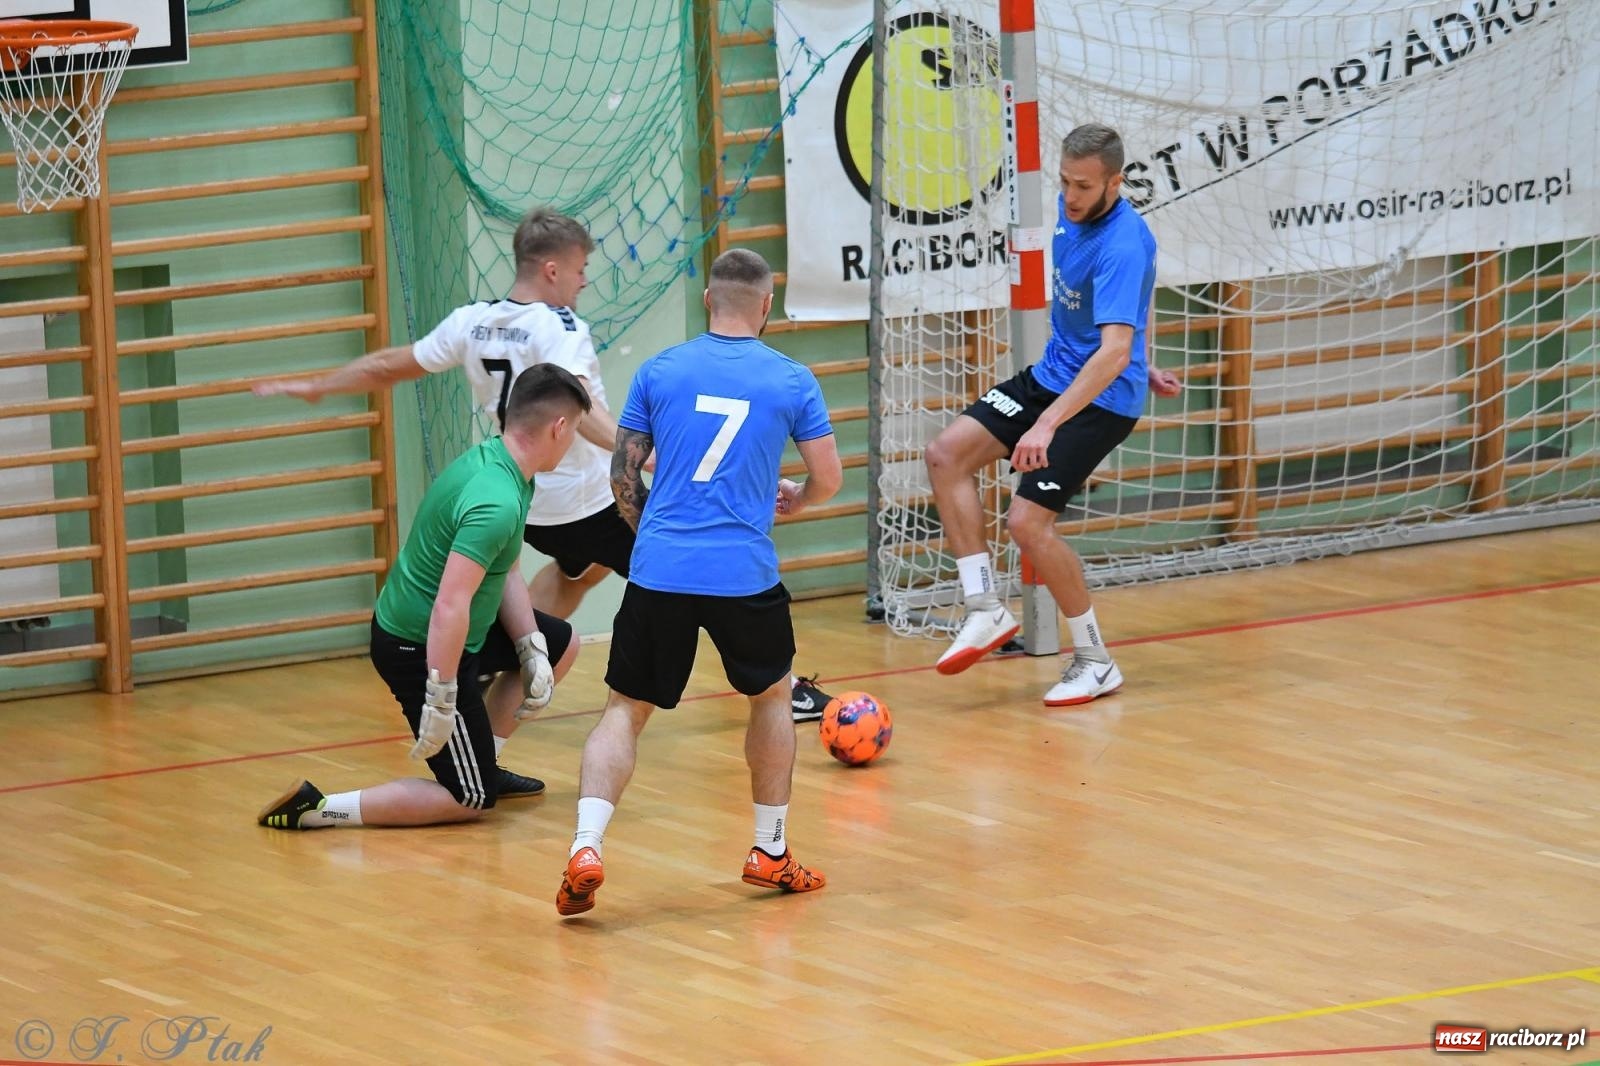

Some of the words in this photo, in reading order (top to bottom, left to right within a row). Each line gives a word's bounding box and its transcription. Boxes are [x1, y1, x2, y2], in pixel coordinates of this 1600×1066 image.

[1196, 115, 1249, 173] W
[1269, 167, 1572, 230] www.osir-raciborz.pl
[980, 388, 1024, 417] SPORT
[691, 393, 751, 482] 7
